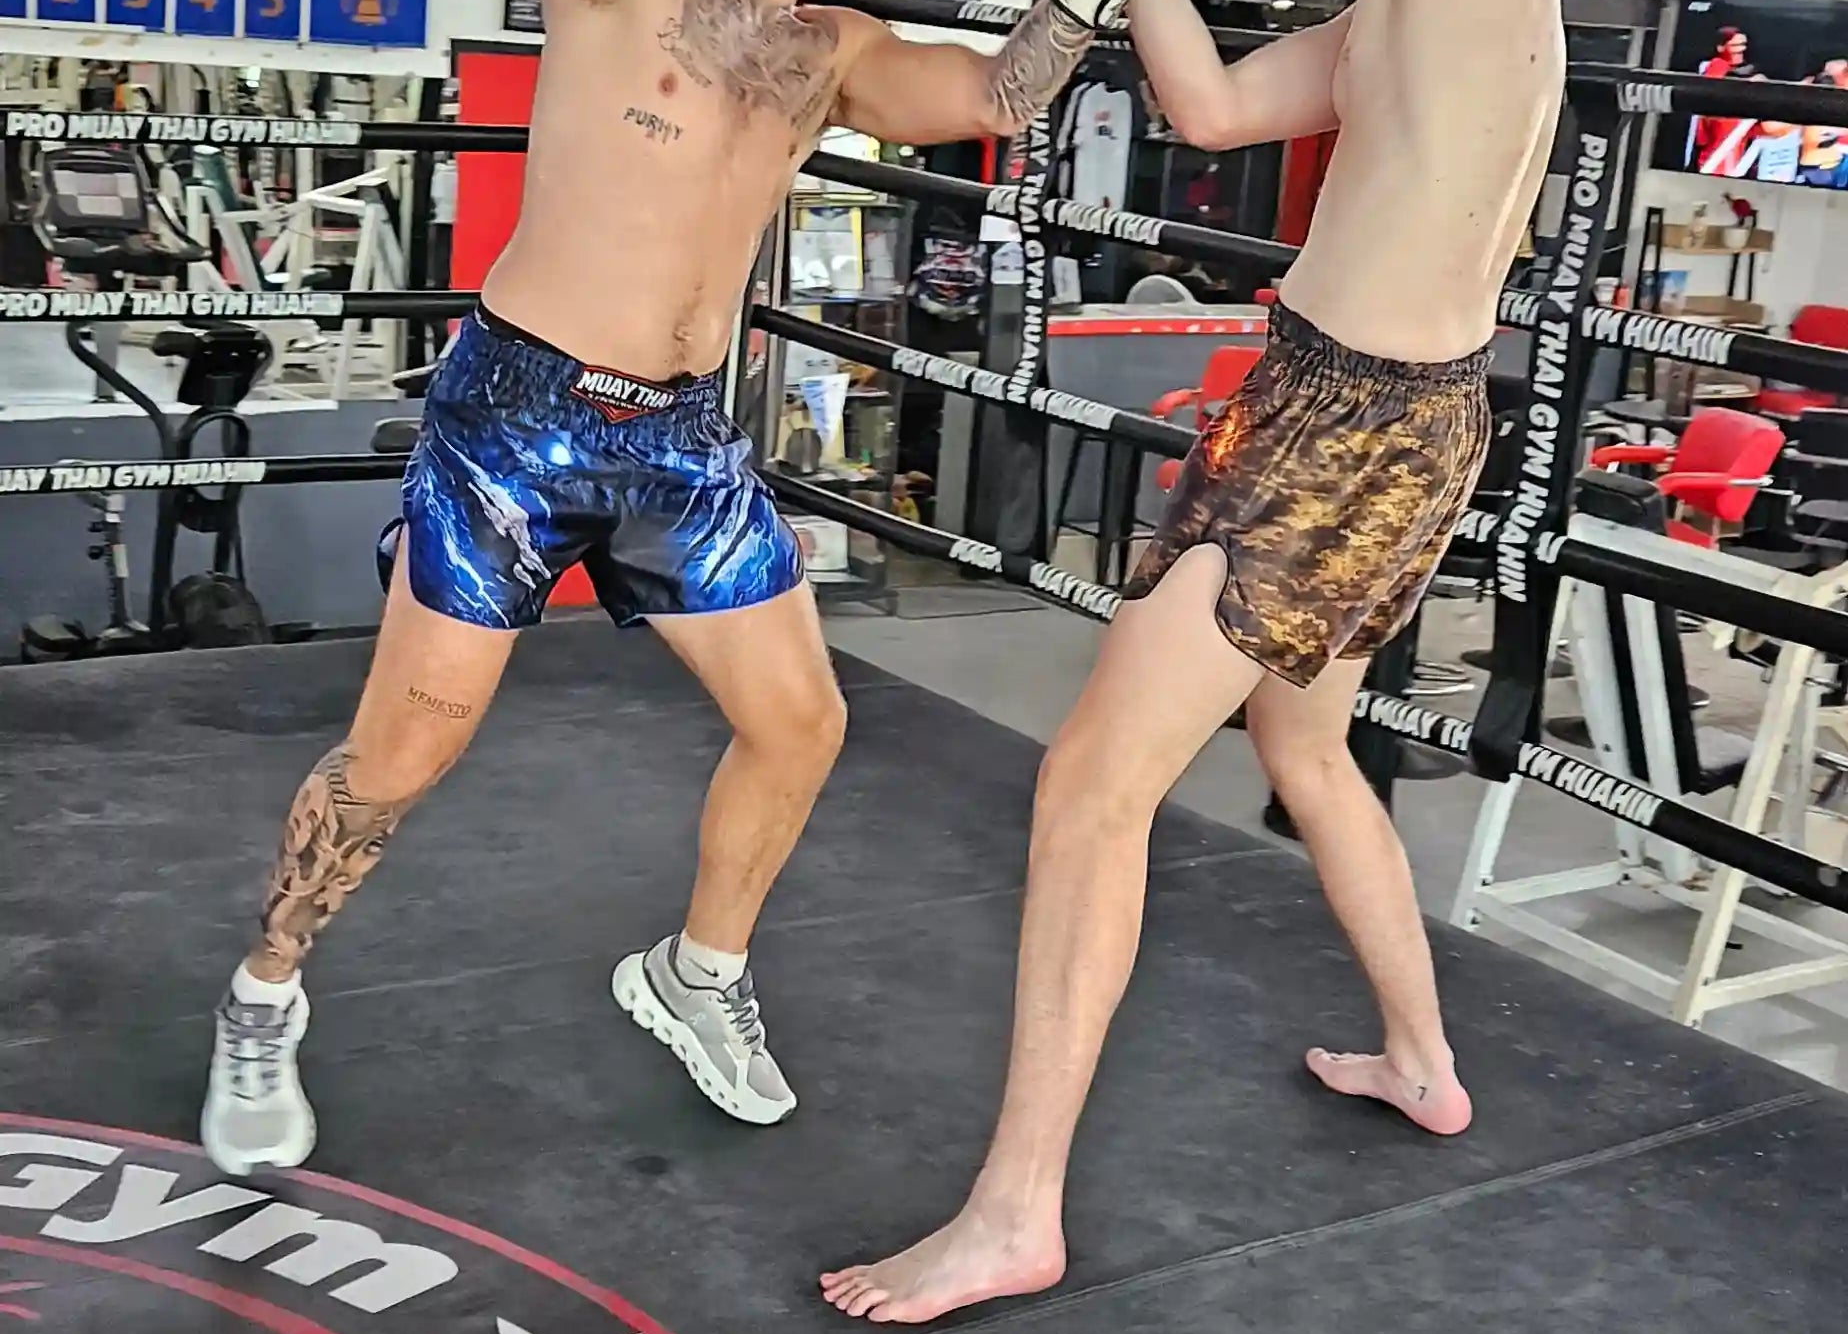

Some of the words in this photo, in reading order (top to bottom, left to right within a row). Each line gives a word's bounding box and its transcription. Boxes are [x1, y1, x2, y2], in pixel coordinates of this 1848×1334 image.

[6, 112, 66, 138] PRO
[68, 114, 145, 139] MUAY
[147, 116, 208, 141] THAI
[209, 118, 268, 143] GYM
[1029, 105, 1051, 167] UAY
[1018, 172, 1046, 234] THAI
[1573, 133, 1608, 207] PRO
[1024, 238, 1046, 300] GYM
[1547, 213, 1594, 314] MUAY
[0, 292, 48, 317] PRO
[49, 291, 127, 317] MUAY
[129, 292, 190, 316] THAI
[191, 291, 250, 316] GYM
[1500, 290, 1540, 326] TH
[1581, 305, 1627, 344] YM
[1622, 313, 1738, 366] HUAHIN
[576, 370, 638, 400] MUAY
[634, 386, 675, 408] THAI
[1006, 304, 1044, 404] HUAHIN
[1532, 319, 1571, 399] THAI
[50, 466, 112, 491] THAI
[113, 464, 171, 487] GYM
[1521, 402, 1560, 479] GYM
[1496, 479, 1549, 603] HUAHIN
[1369, 696, 1443, 740] MUAY
[1441, 718, 1474, 752] TH
[1518, 742, 1561, 782] YM
[1554, 759, 1665, 827] HUAHIN
[0, 1133, 459, 1314] Gym
